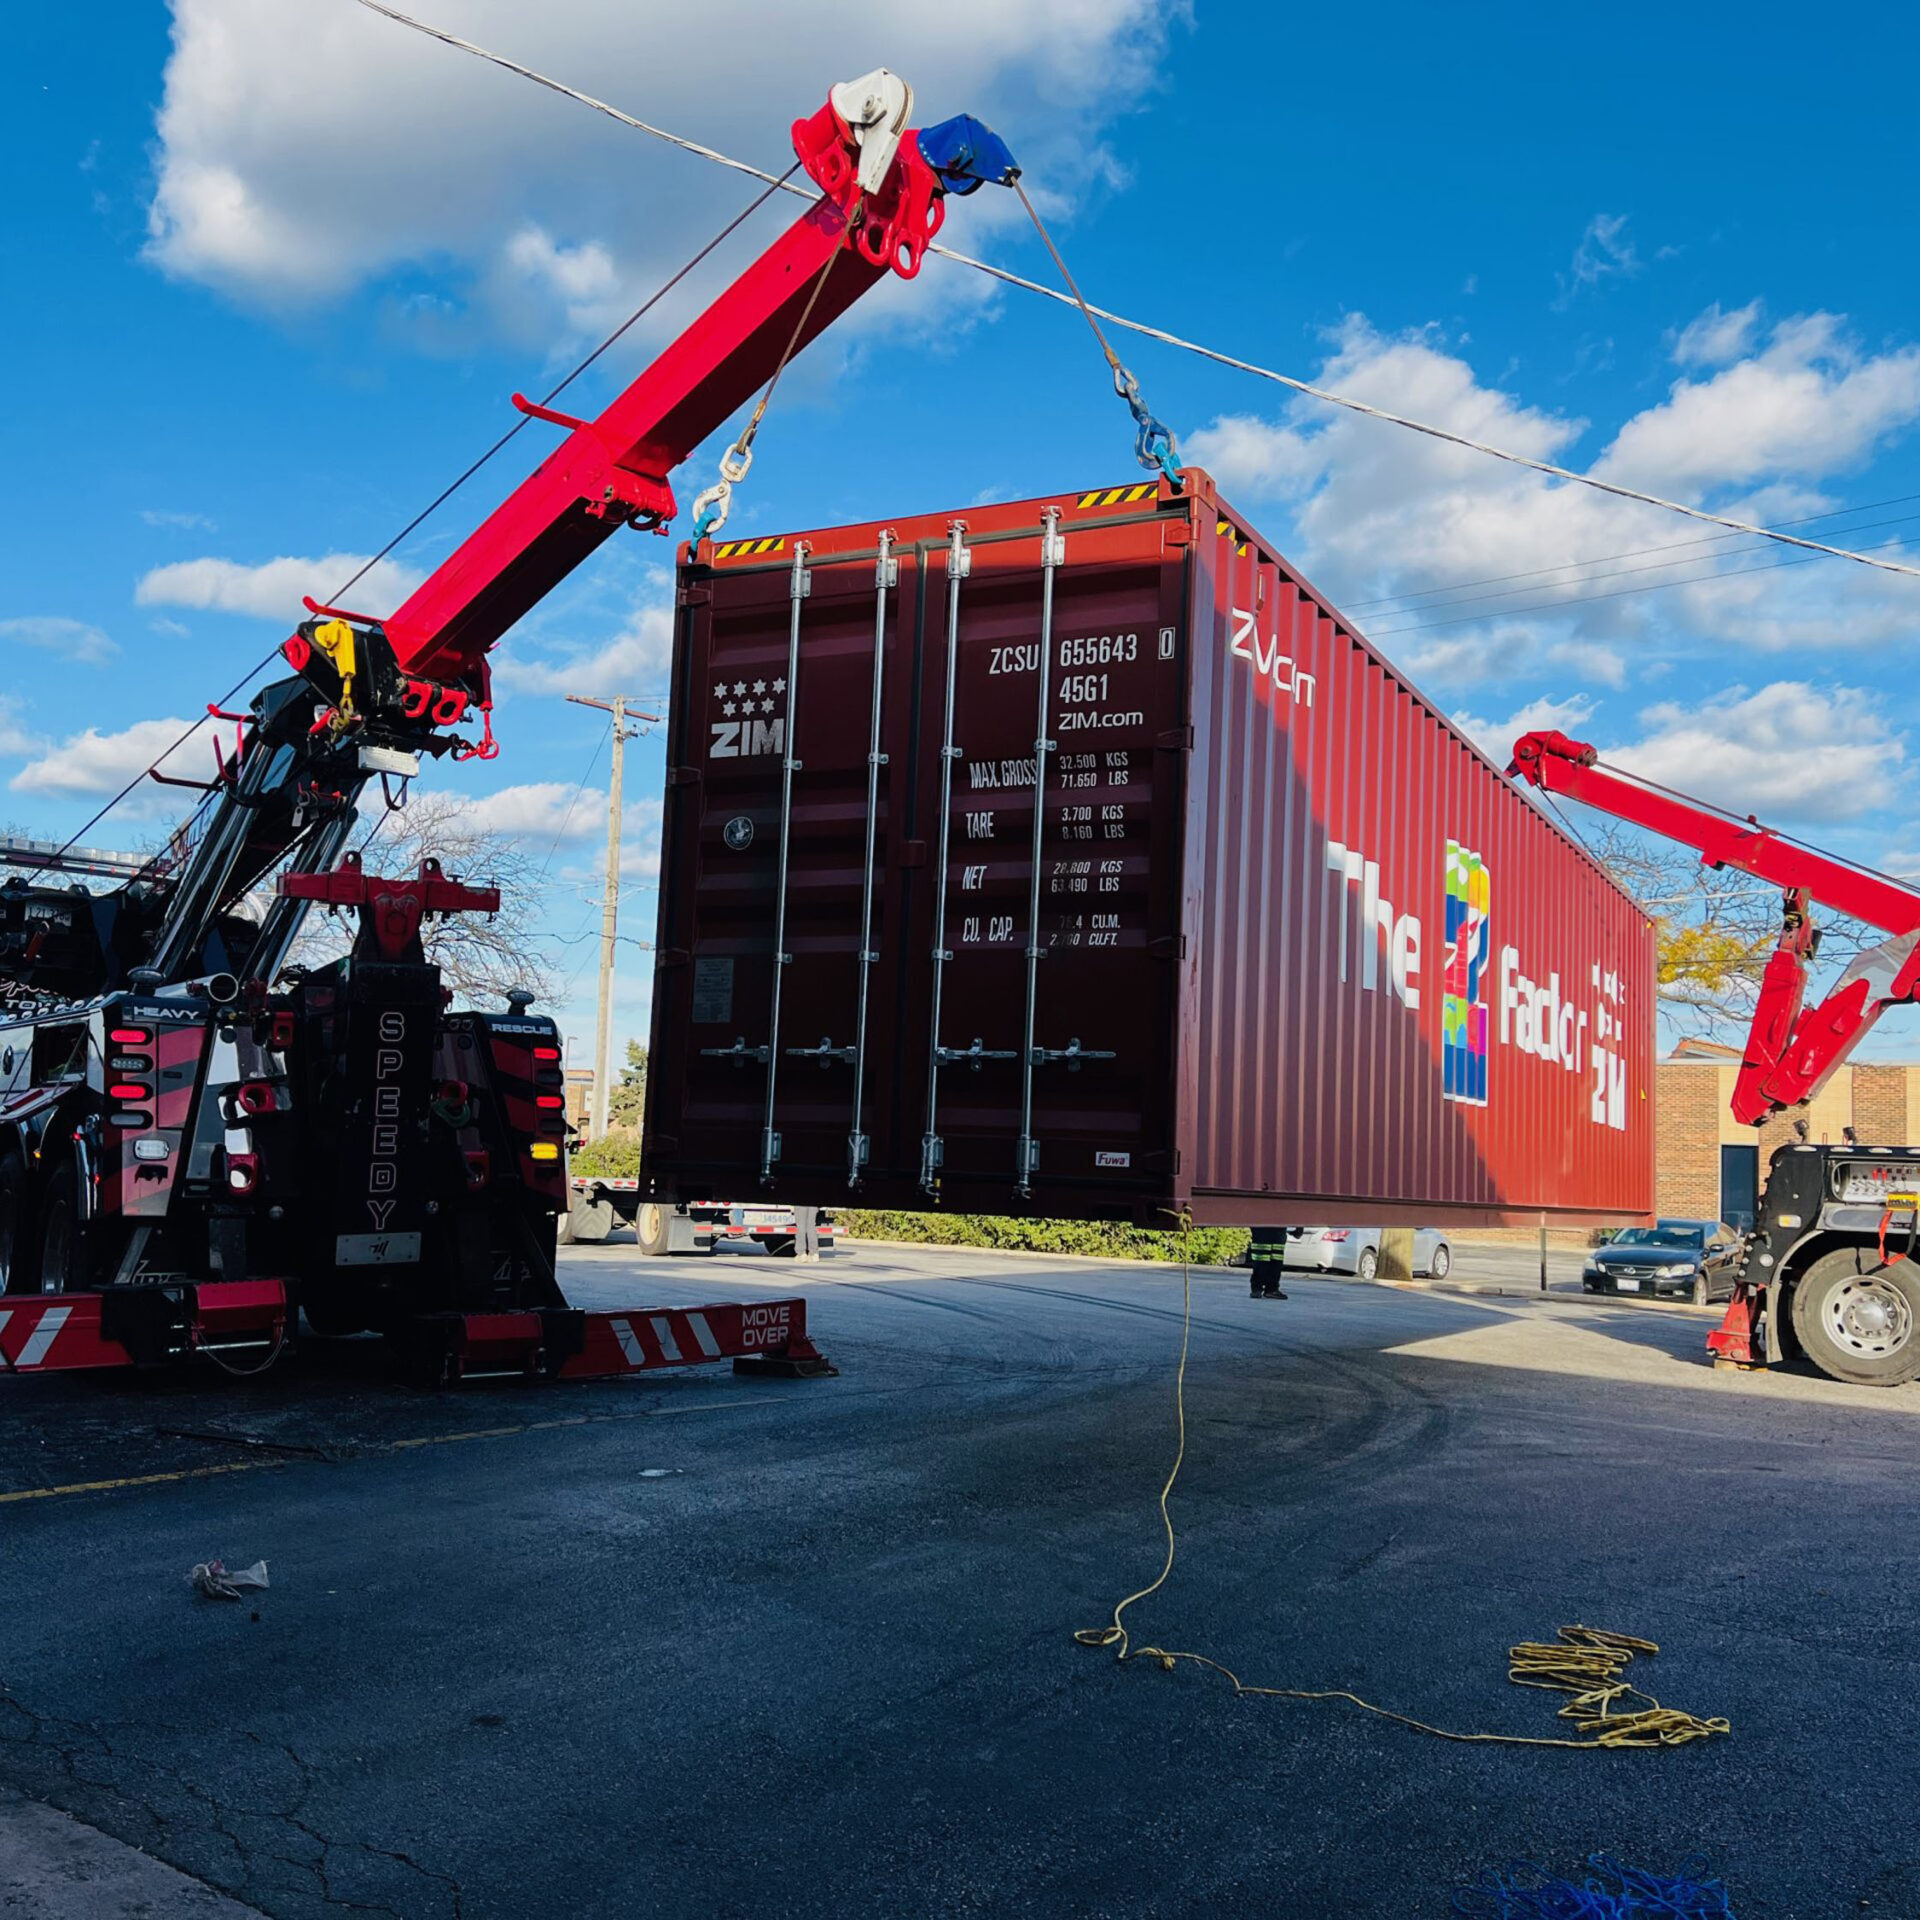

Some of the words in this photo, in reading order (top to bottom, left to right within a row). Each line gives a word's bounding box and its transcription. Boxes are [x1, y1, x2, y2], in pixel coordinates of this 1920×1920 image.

[988, 643, 1040, 675] ZCSU
[1059, 633, 1138, 668] 655643
[1160, 628, 1174, 658] 0
[1059, 673, 1108, 704] 45G1
[1058, 711, 1144, 730] ZIM.com
[709, 718, 785, 759] ZIM
[1059, 753, 1097, 770] 32.500
[1105, 751, 1129, 767] KGS
[1061, 772, 1097, 788] 71.650
[1108, 770, 1129, 786] LBS
[966, 811, 994, 839] TARE
[1061, 805, 1092, 822] 3.700
[1101, 804, 1124, 820] KGS
[1062, 823, 1093, 841] 8.160
[1104, 823, 1125, 839] LBS
[961, 865, 987, 890] NET
[1100, 859, 1124, 874] KGS
[1099, 876, 1120, 892] LBS
[963, 916, 980, 942] CU.
[988, 916, 1014, 942] CAP.
[1326, 840, 1421, 1010] The
[133, 1005, 199, 1020] HEAVY
[491, 1023, 553, 1036] RESCUE
[366, 1011, 405, 1230] SPEEDY
[742, 1306, 791, 1327] MOVE
[743, 1325, 789, 1347] OVER
